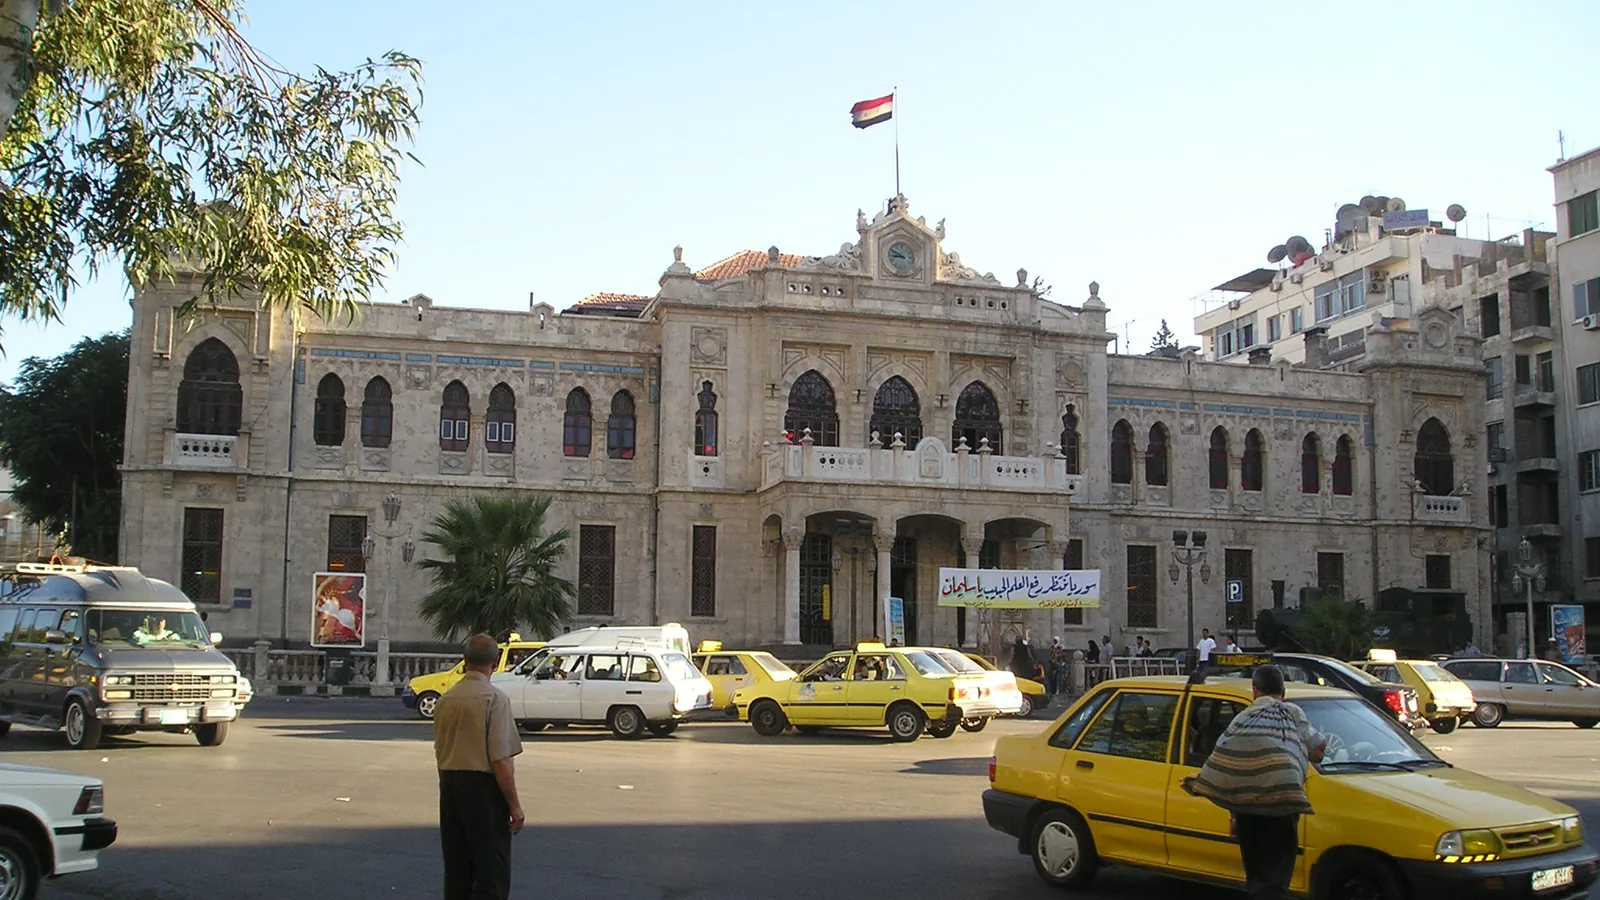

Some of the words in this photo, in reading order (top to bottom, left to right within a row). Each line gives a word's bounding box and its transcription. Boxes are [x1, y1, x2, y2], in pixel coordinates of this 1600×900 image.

[942, 576, 976, 597] سليمان
[976, 576, 983, 598] يا
[983, 577, 1010, 600] الحبيب
[1007, 575, 1029, 601] العلم
[1027, 576, 1043, 598] رفع
[1067, 576, 1097, 596] سوريا
[1230, 583, 1239, 600] P
